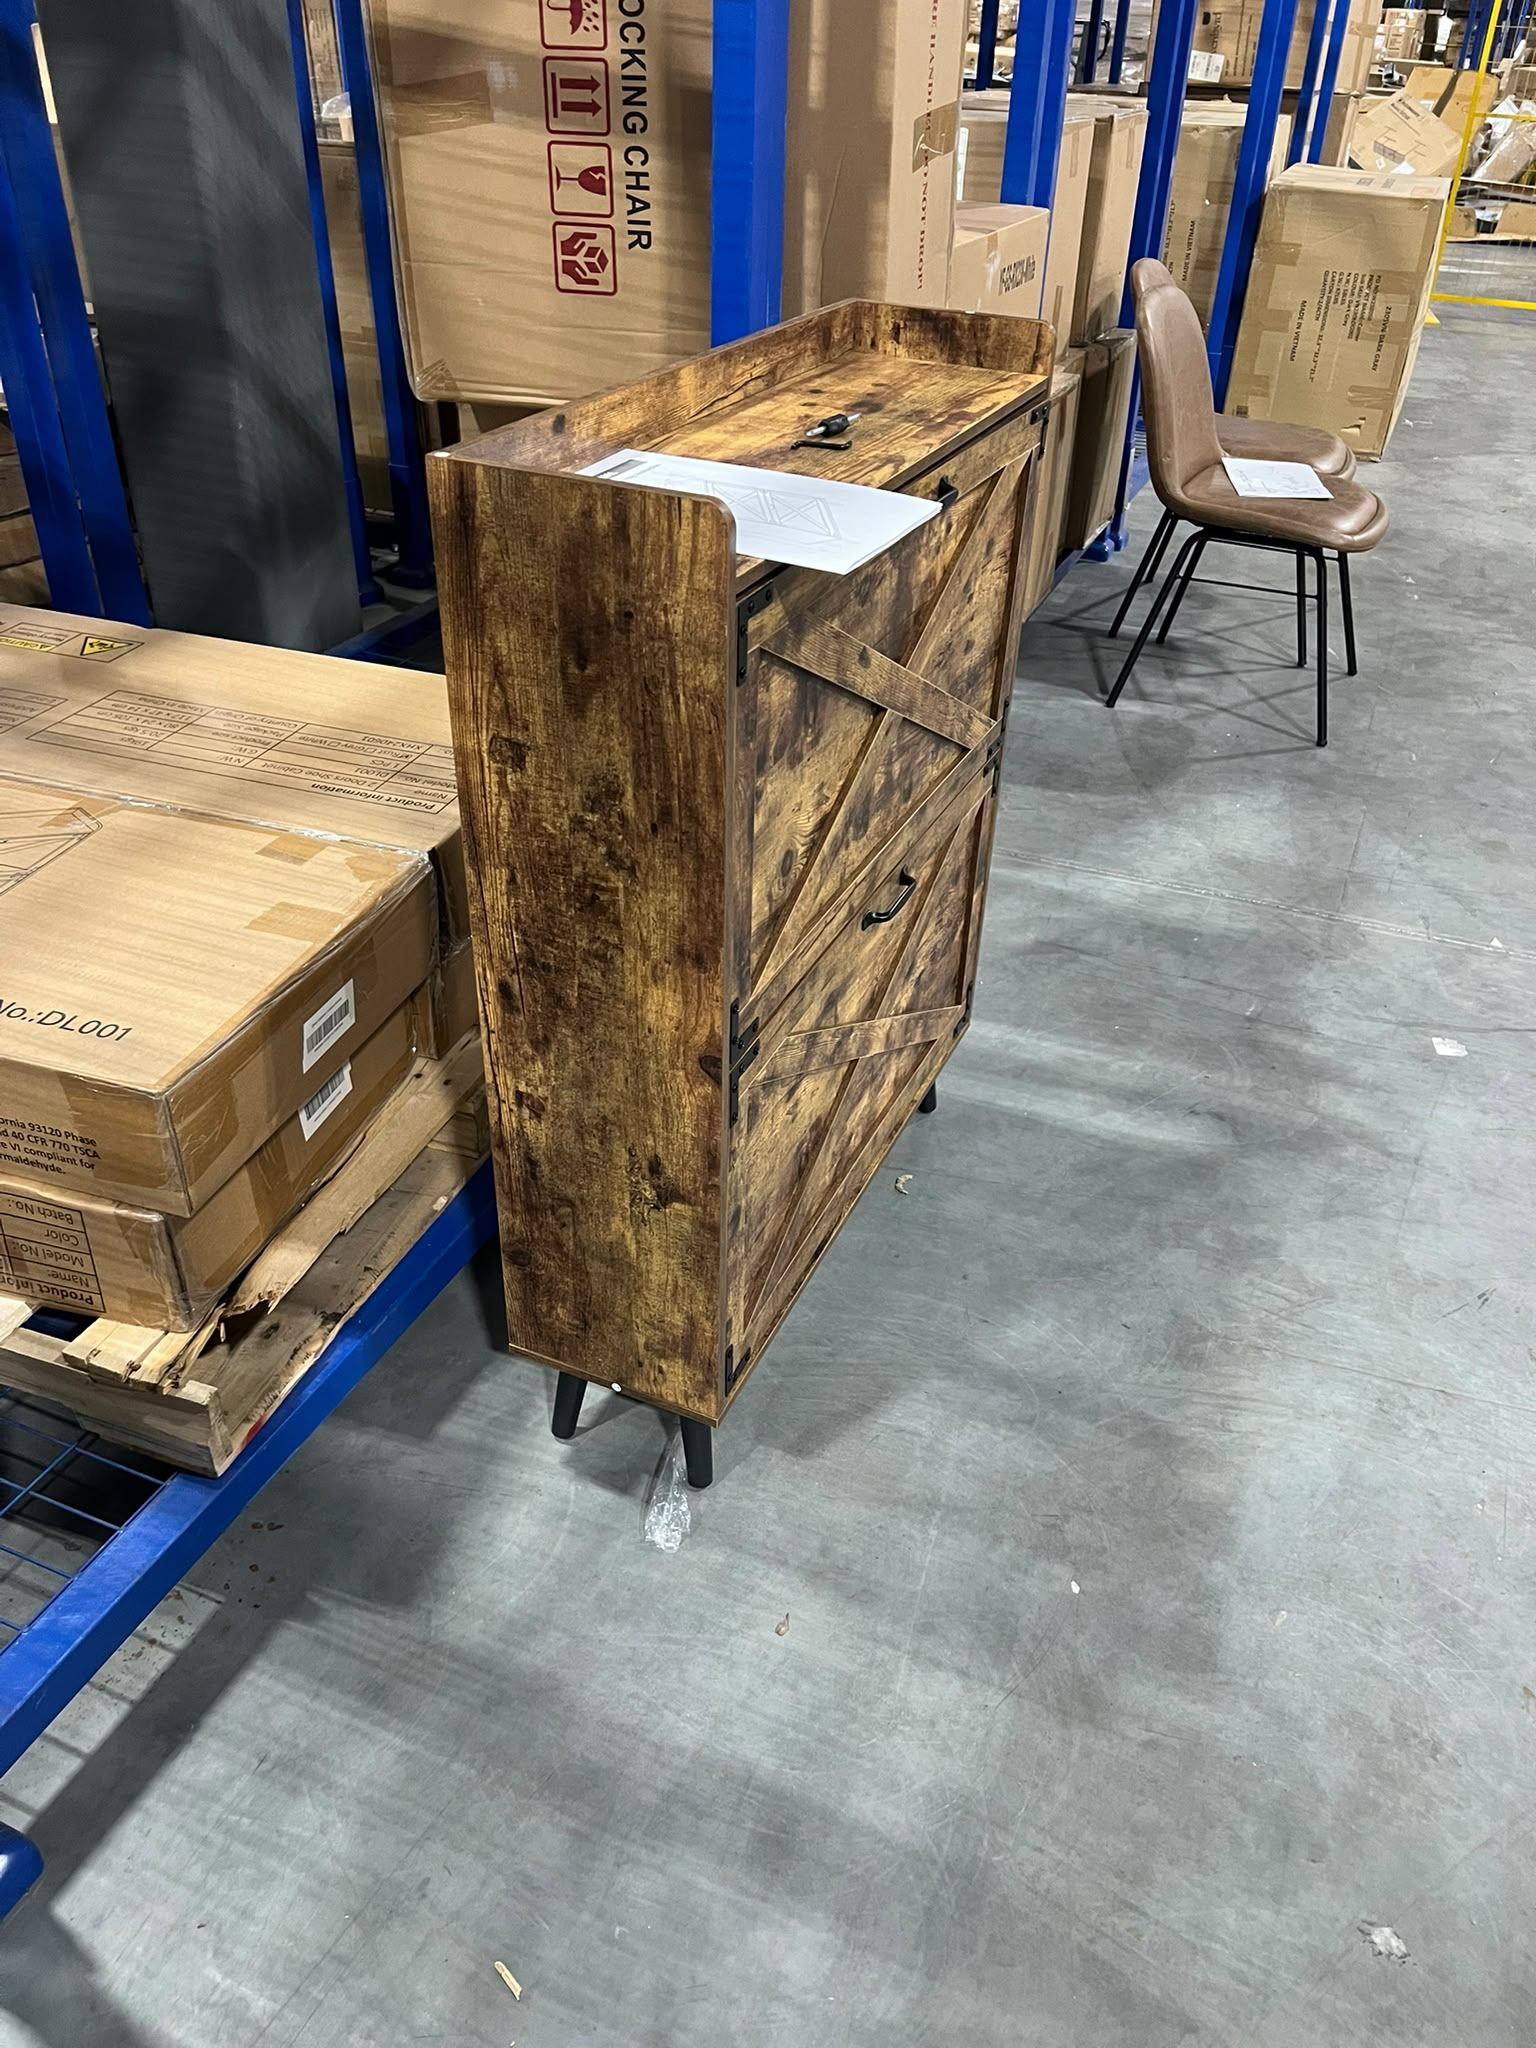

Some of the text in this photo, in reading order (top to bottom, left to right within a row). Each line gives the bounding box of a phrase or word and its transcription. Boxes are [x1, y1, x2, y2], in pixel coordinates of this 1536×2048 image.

[623, 145, 652, 250] CHAIR
[1187, 220, 1196, 251] VIETNAM
[1290, 300, 1307, 362] MADE IN VIETNAM
[1376, 334, 1386, 354] DARK
[1371, 354, 1381, 372] GRAY
[261, 762, 303, 776] Cabinet
[304, 770, 333, 781] Shoe
[354, 767, 390, 778] DL001
[334, 775, 367, 786] Doors
[311, 783, 435, 810] Product information
[28, 1122, 62, 1137] 93120
[64, 1131, 97, 1146] Phase
[12, 1130, 24, 1141] 40
[27, 1134, 48, 1147] CFR
[49, 1139, 70, 1152] 770
[71, 1145, 101, 1160] TSCA
[24, 1147, 78, 1166] compliant
[80, 1158, 95, 1170] for
[37, 1208, 73, 1225] Batch
[44, 1229, 79, 1246] Color
[42, 1249, 84, 1267] Model
[46, 1269, 89, 1288] Name:
[38, 1283, 94, 1305] Product
